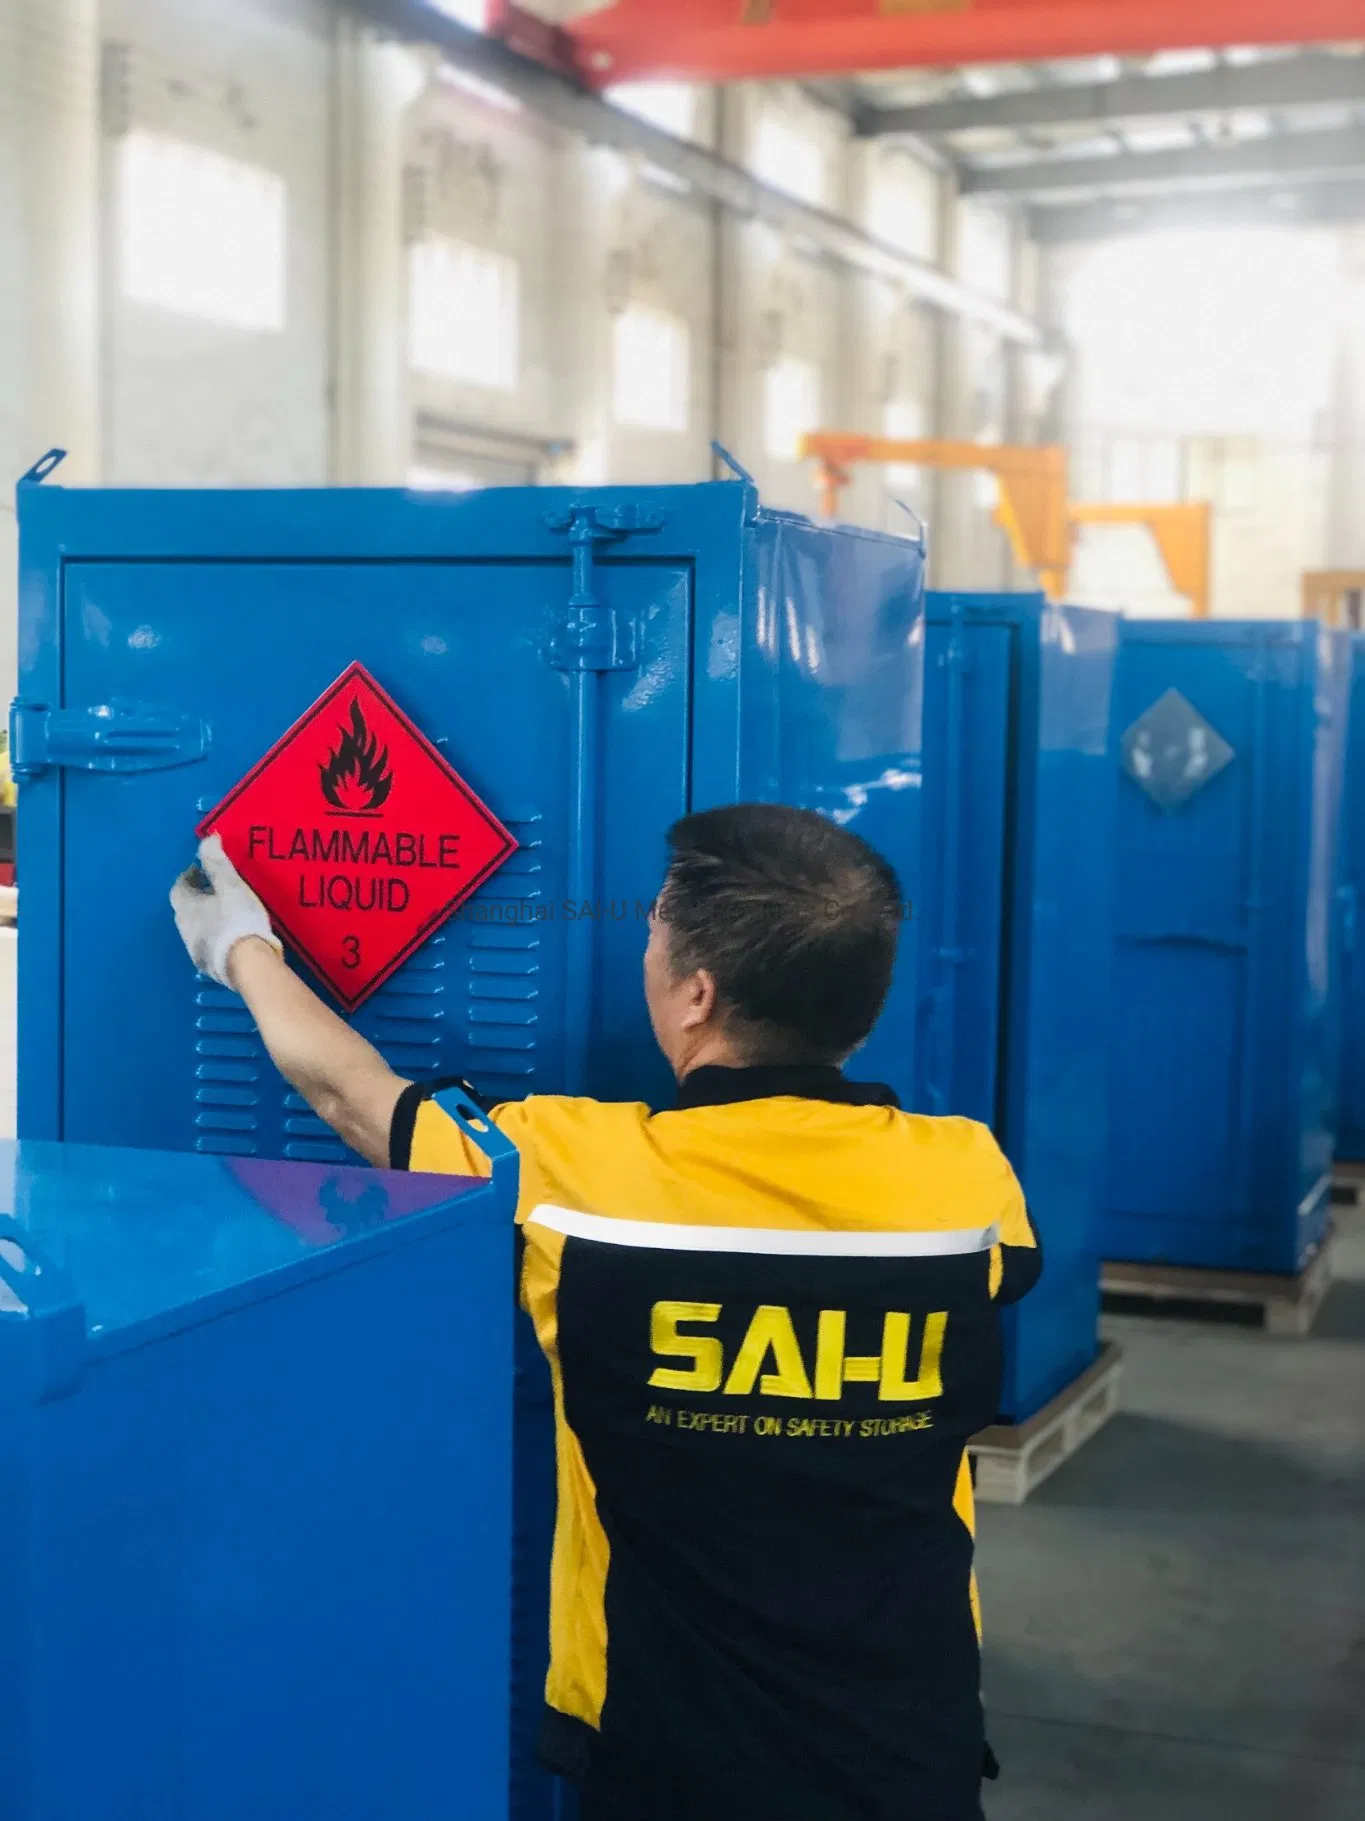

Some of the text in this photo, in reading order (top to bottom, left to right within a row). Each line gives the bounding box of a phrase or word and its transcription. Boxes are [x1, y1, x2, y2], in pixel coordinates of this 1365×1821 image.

[248, 825, 461, 869] FLAMMABLE
[299, 875, 410, 912] LIQUID
[341, 935, 362, 970] 3
[646, 1405, 934, 1438] AN EXPERT ON SAFETY STORAGE
